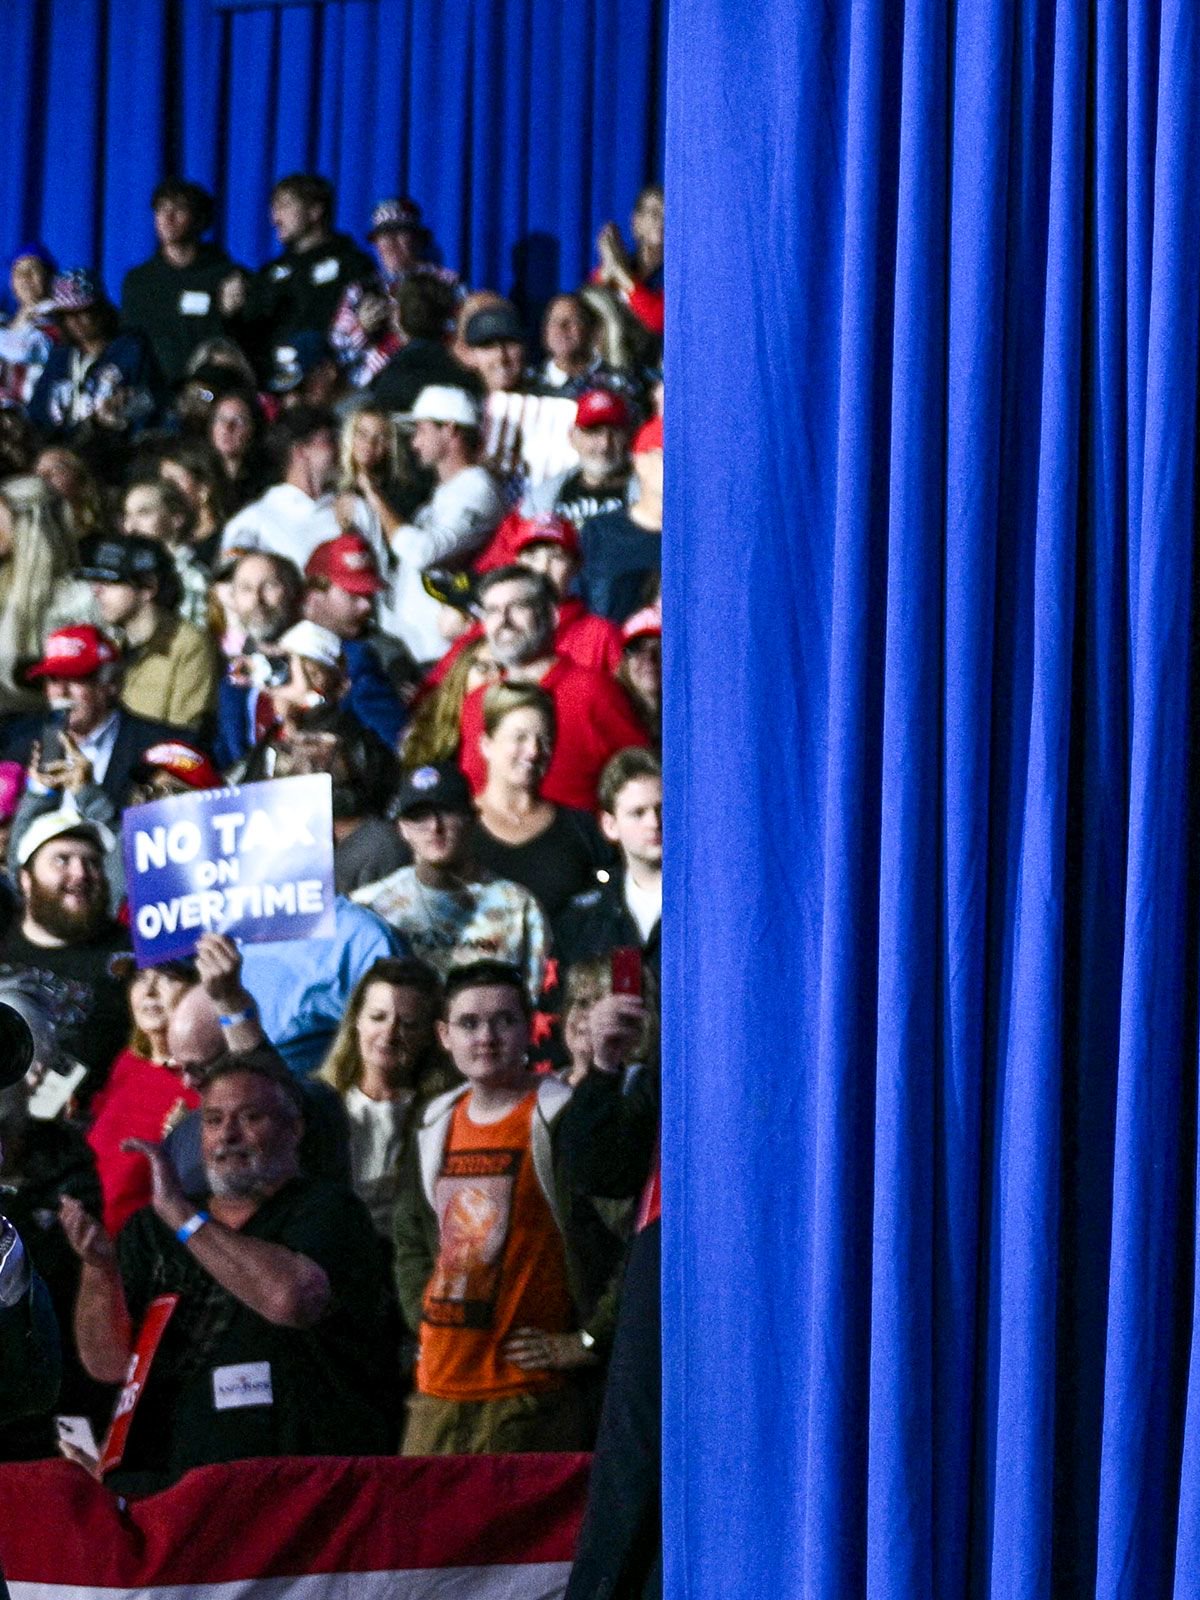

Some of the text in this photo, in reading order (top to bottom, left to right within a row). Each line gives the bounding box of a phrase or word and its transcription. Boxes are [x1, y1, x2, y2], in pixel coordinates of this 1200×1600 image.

[135, 809, 315, 873] NO TAX
[196, 858, 240, 887] ON
[137, 879, 324, 939] OVERTIME
